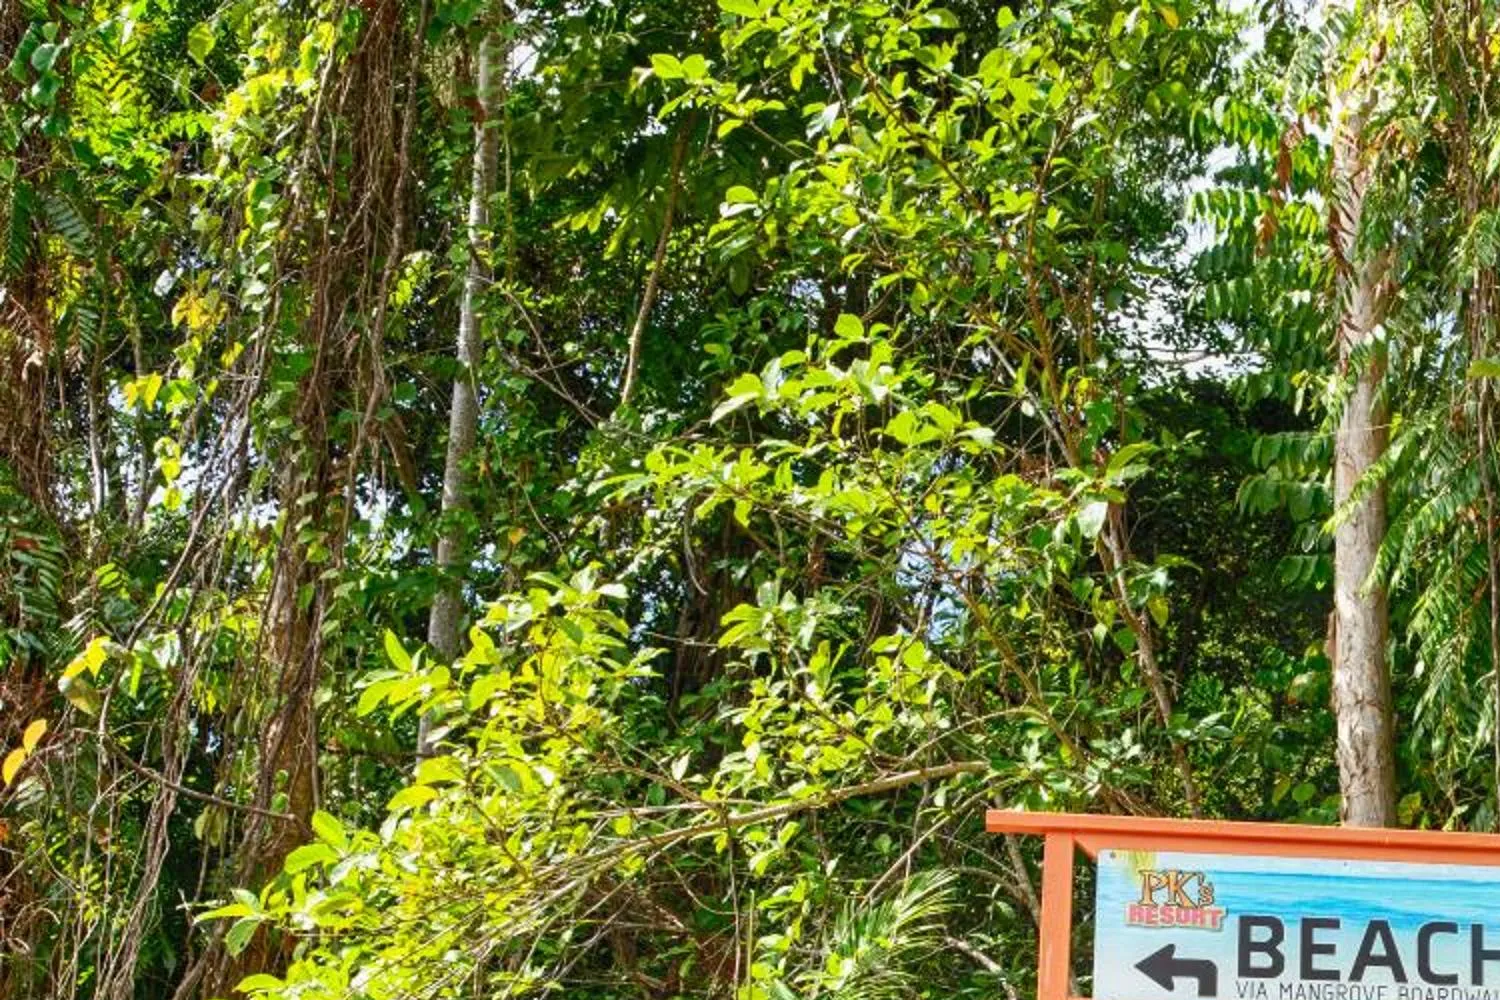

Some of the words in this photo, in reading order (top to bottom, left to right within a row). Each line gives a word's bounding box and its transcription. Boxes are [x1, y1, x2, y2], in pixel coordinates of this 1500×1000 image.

[1138, 869, 1214, 908] PK's
[1128, 903, 1222, 928] RESORT
[1235, 981, 1269, 1000] VIA
